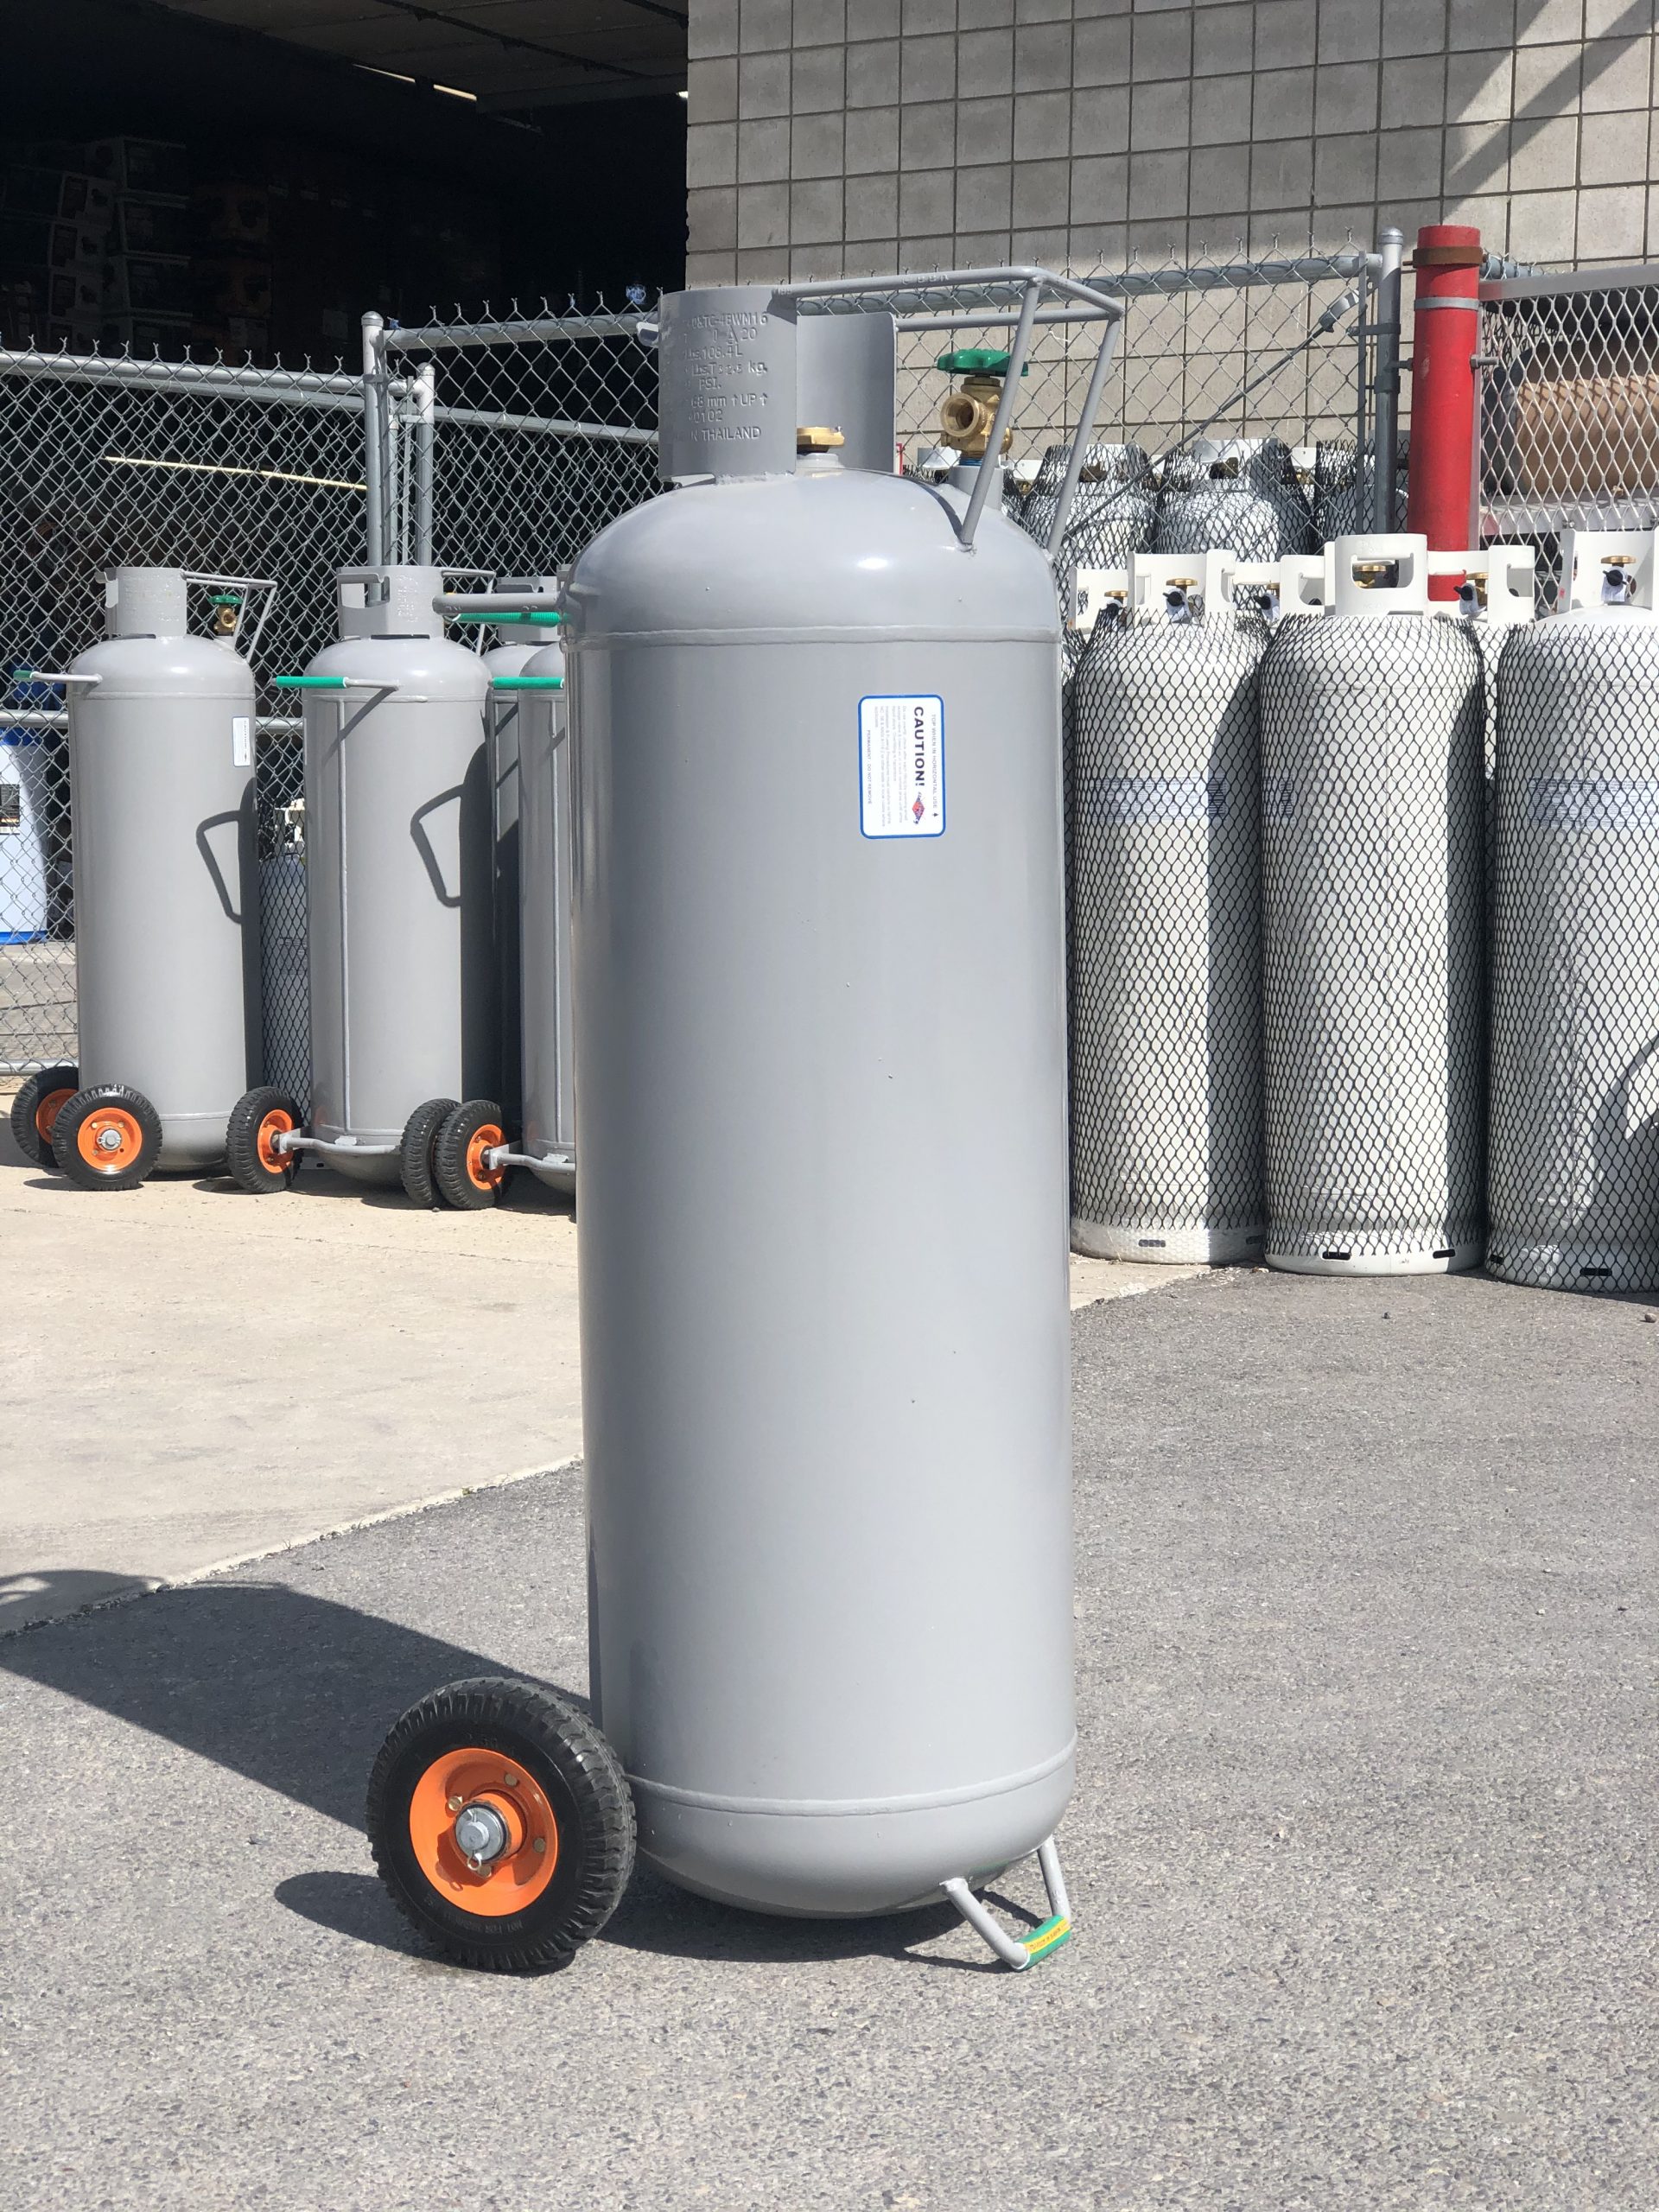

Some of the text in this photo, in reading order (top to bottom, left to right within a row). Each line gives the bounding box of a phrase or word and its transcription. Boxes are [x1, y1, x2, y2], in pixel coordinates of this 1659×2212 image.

[707, 396, 727, 407] mm
[740, 393, 758, 407] UP
[702, 426, 762, 442] THAILAND
[913, 706, 925, 787] CAUTION!
